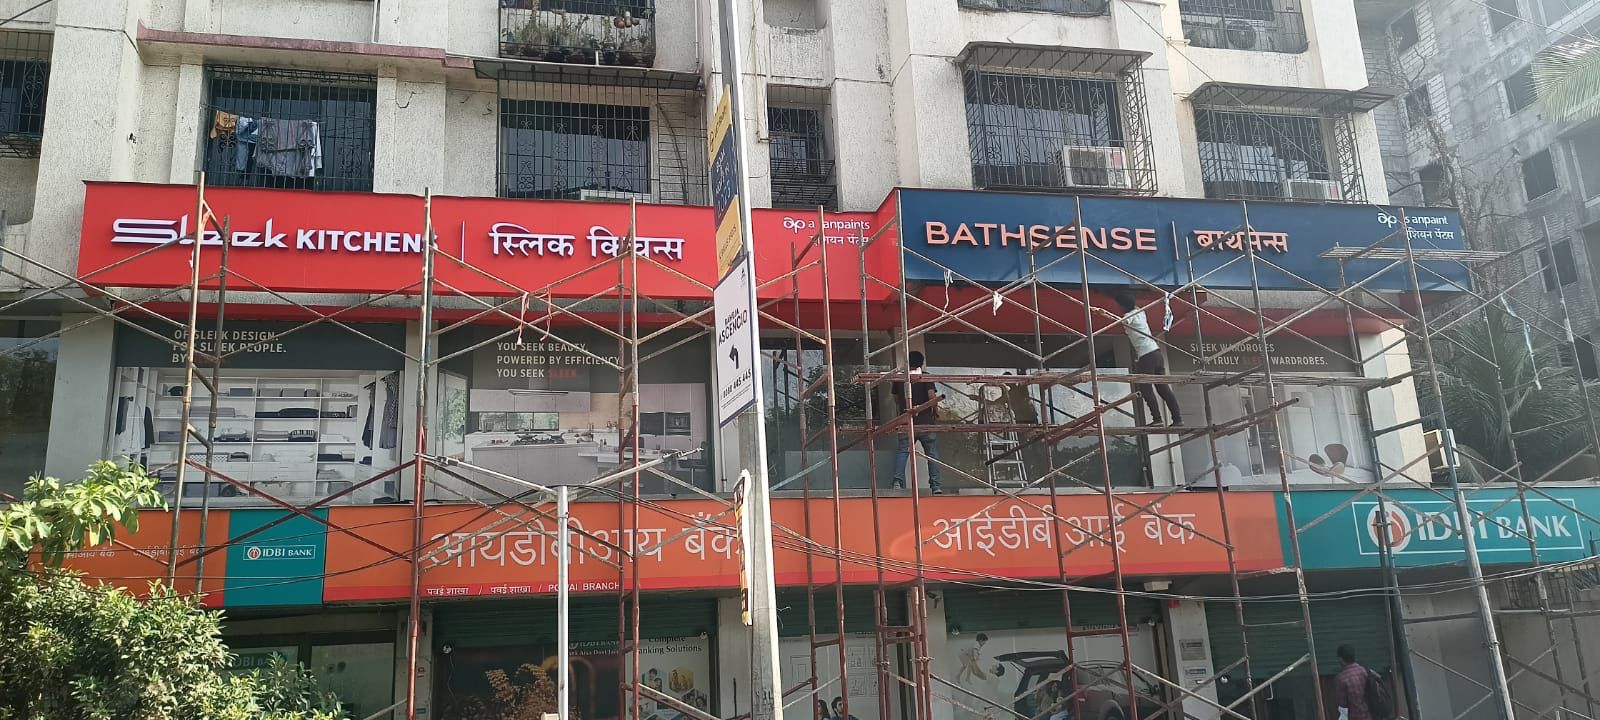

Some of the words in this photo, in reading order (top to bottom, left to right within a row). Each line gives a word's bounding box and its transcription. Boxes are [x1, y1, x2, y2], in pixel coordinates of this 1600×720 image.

[488, 222, 575, 257] स्लिक
[925, 221, 1158, 251] BATHSENSE
[718, 309, 748, 346] ASCENCIO
[233, 331, 279, 341] DESIGN.
[240, 343, 287, 353] PEOPLE.
[497, 342, 517, 351] YOU
[520, 342, 545, 352] SEEK
[172, 353, 187, 363] BY
[497, 355, 546, 365] POWERED
[549, 356, 561, 365] BY
[1271, 356, 1328, 366] WARDROBES.
[497, 368, 517, 378] YOU
[520, 369, 545, 378] SEEK
[1495, 515, 1572, 540] BANK
[262, 548, 286, 557] IDBI
[583, 582, 620, 591] BRANCH
[640, 645, 664, 656] anking
[666, 643, 702, 654] Solutions
